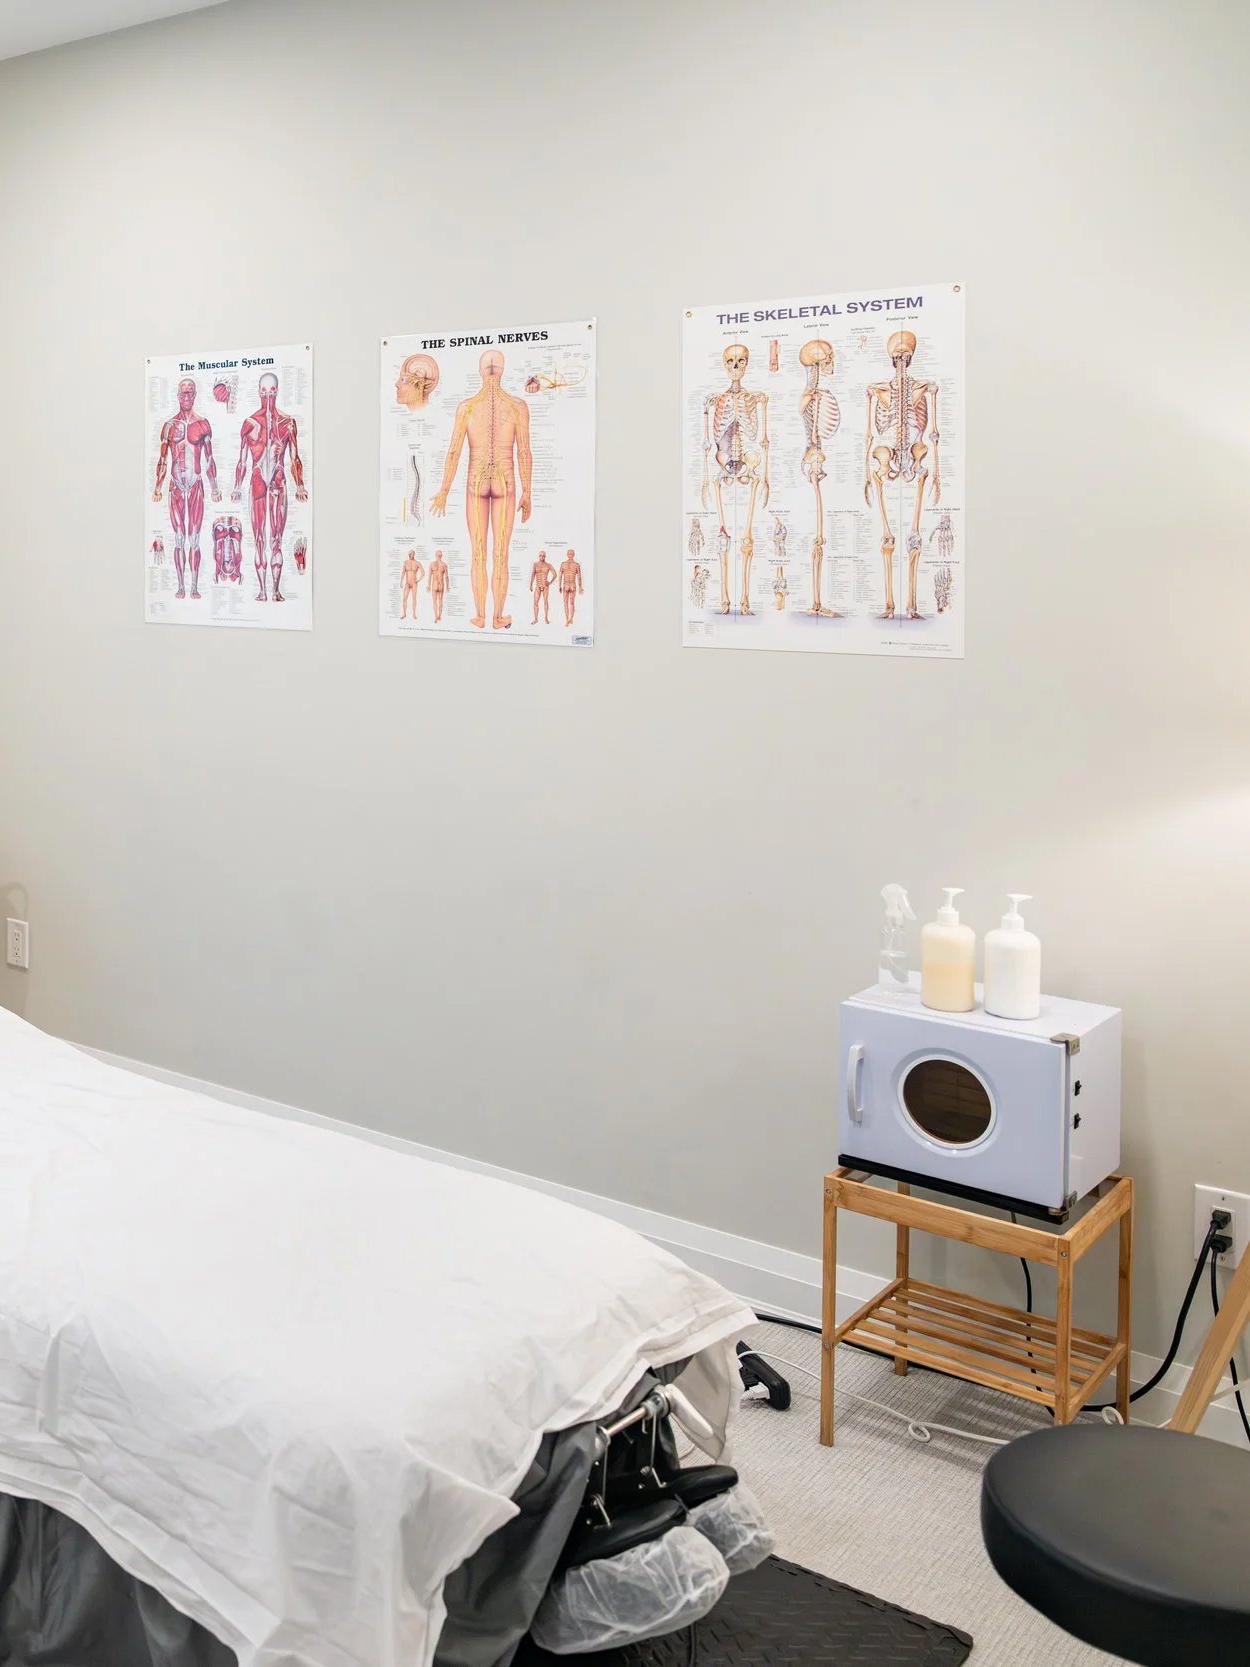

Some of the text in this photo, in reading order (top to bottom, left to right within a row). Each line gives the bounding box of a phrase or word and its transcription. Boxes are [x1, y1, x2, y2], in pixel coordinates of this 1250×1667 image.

[716, 296, 924, 325] THE SKELETAL SYSTEM
[421, 330, 549, 350] THE SPINAL NERVES
[179, 357, 275, 372] The Muscular System
